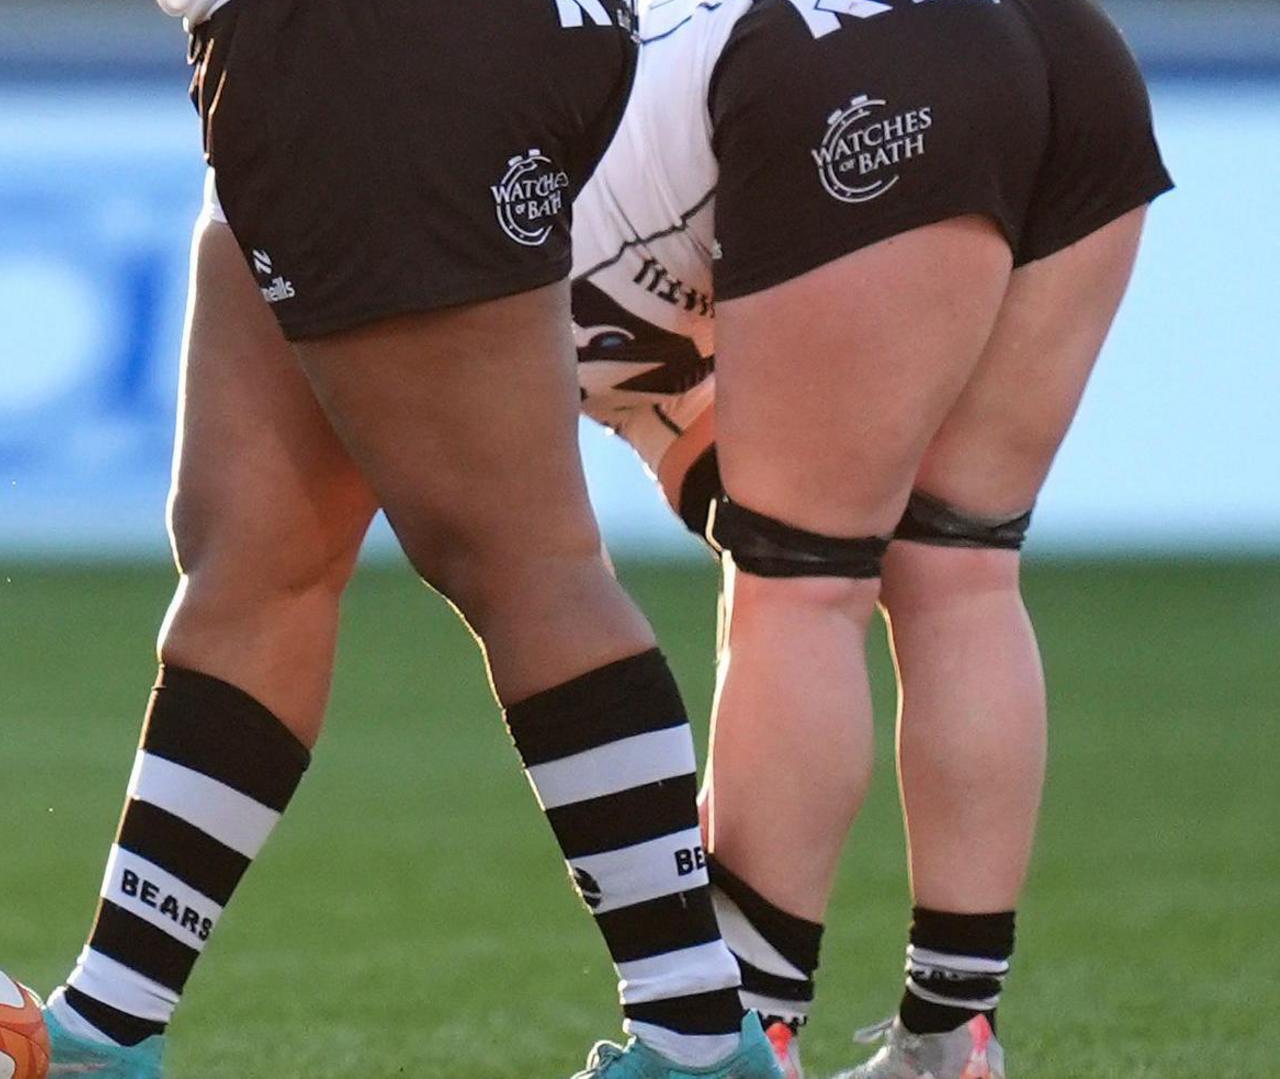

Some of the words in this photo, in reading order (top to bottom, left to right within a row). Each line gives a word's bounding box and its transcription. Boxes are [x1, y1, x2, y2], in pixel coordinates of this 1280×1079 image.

[811, 107, 932, 167] WATCHES
[859, 134, 925, 175] BATH
[121, 868, 213, 942] BEARS
